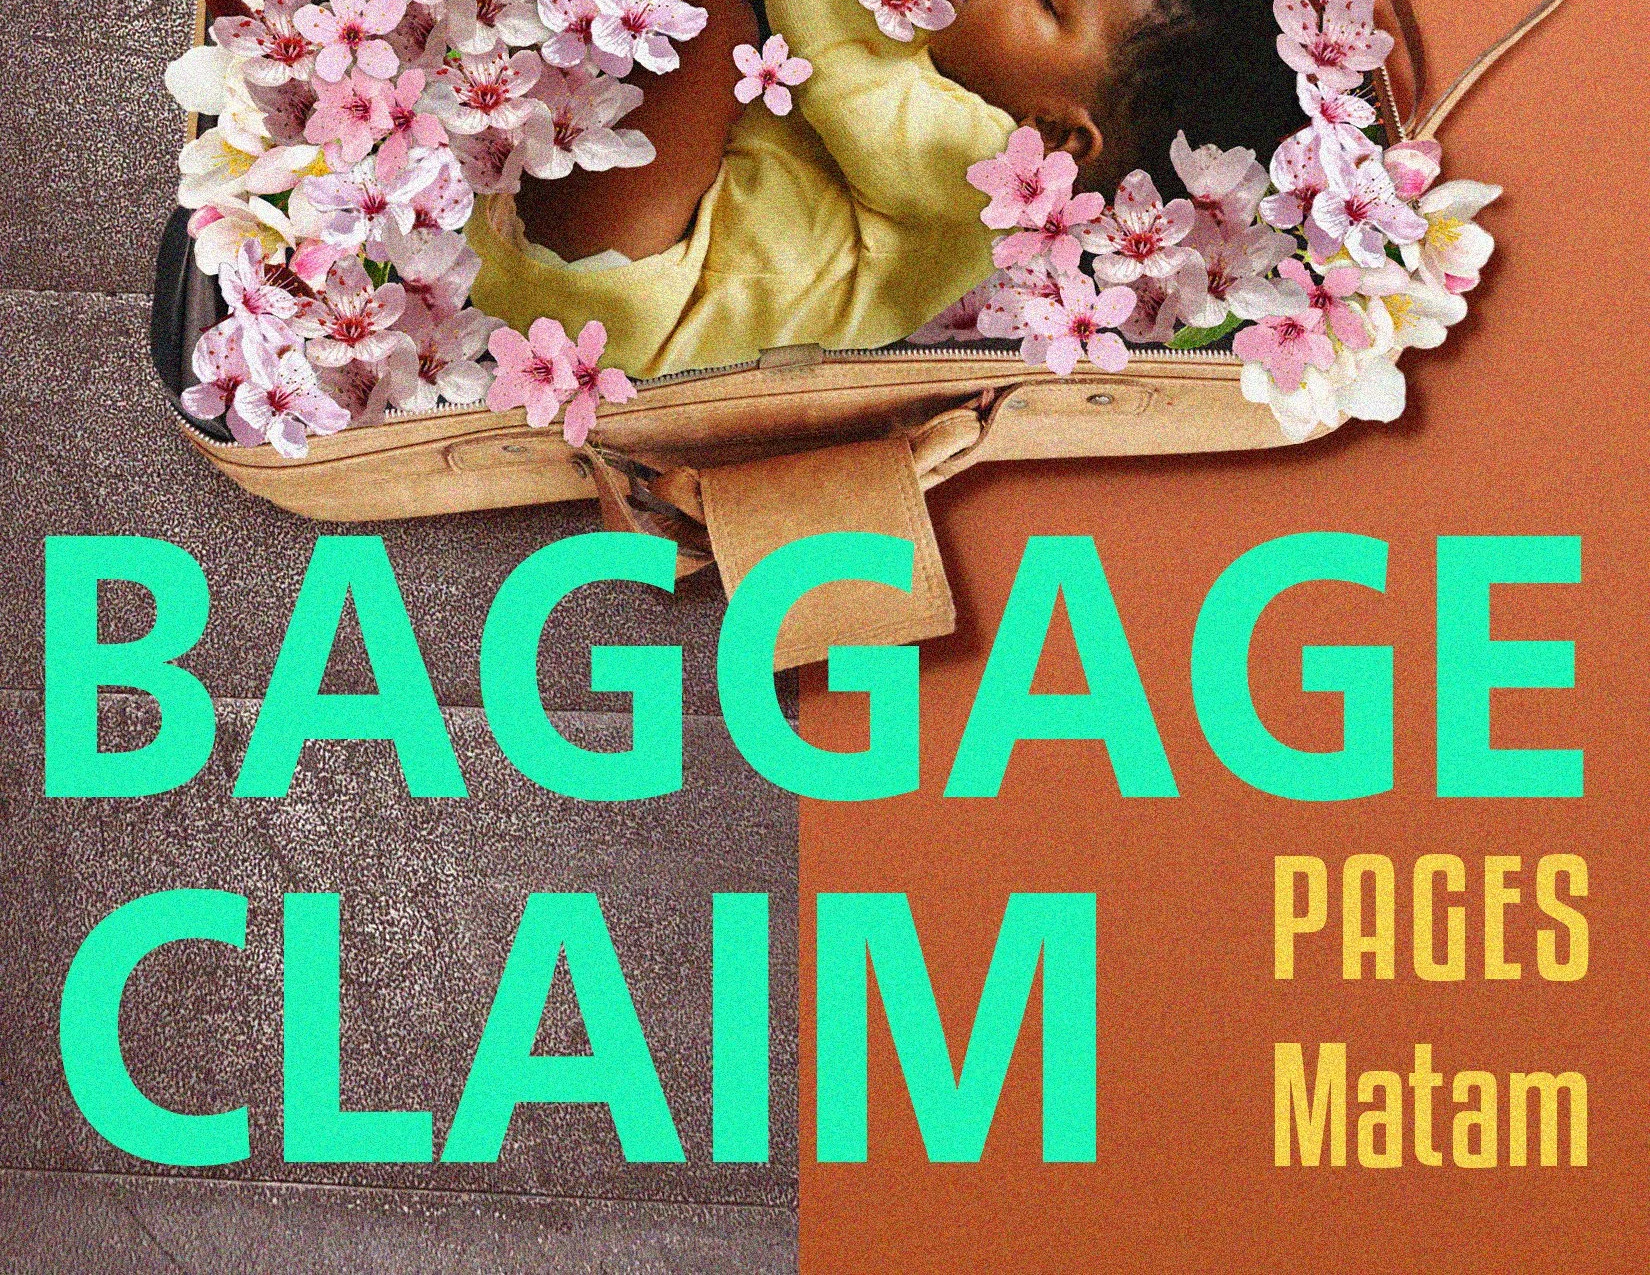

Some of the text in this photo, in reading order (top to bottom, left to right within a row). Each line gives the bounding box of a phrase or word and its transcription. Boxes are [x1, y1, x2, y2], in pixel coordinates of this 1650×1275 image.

[44, 531, 1584, 802] BAGGAGE
[1274, 853, 1590, 982] PAGES
[59, 889, 1097, 1167] CLAIM
[1274, 1042, 1588, 1169] Matam
